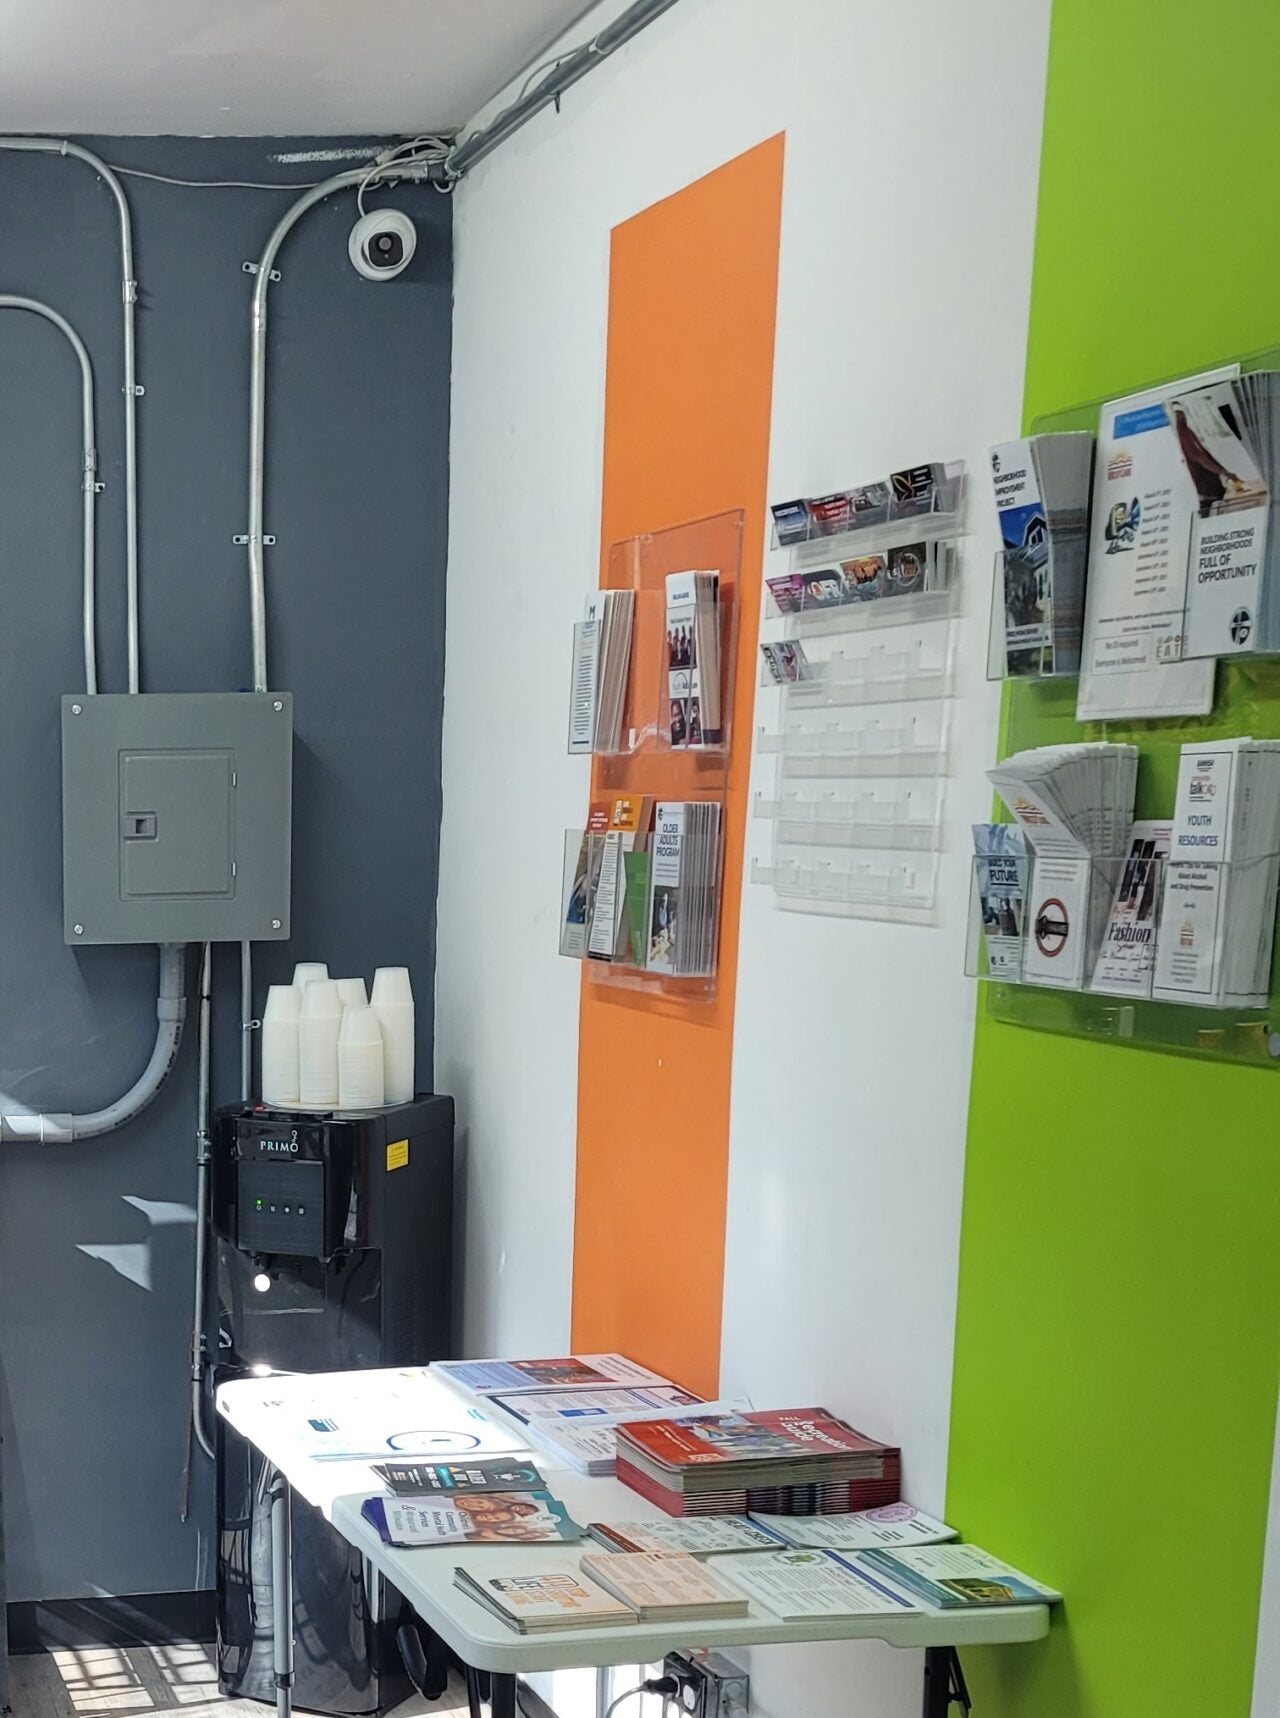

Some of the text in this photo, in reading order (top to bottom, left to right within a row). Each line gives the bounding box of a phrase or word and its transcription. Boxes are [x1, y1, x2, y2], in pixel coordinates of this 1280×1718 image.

[1200, 527, 1255, 545] BUILDING STRONG
[1200, 538, 1253, 554] NEIGHBORHOODS
[1199, 553, 1232, 569] FULL OF
[1198, 563, 1258, 583] OPPORTUNITY
[1188, 815, 1212, 826] YOUTH
[663, 823, 678, 833] OLDER
[659, 834, 678, 845] ADULTS
[1178, 835, 1218, 847] RESOURCES
[656, 846, 680, 857] PROGRAM
[990, 870, 1019, 882] FUTURE
[1108, 921, 1151, 943] Fashion
[260, 1141, 299, 1152] PRIMO
[780, 1422, 815, 1441] Guide
